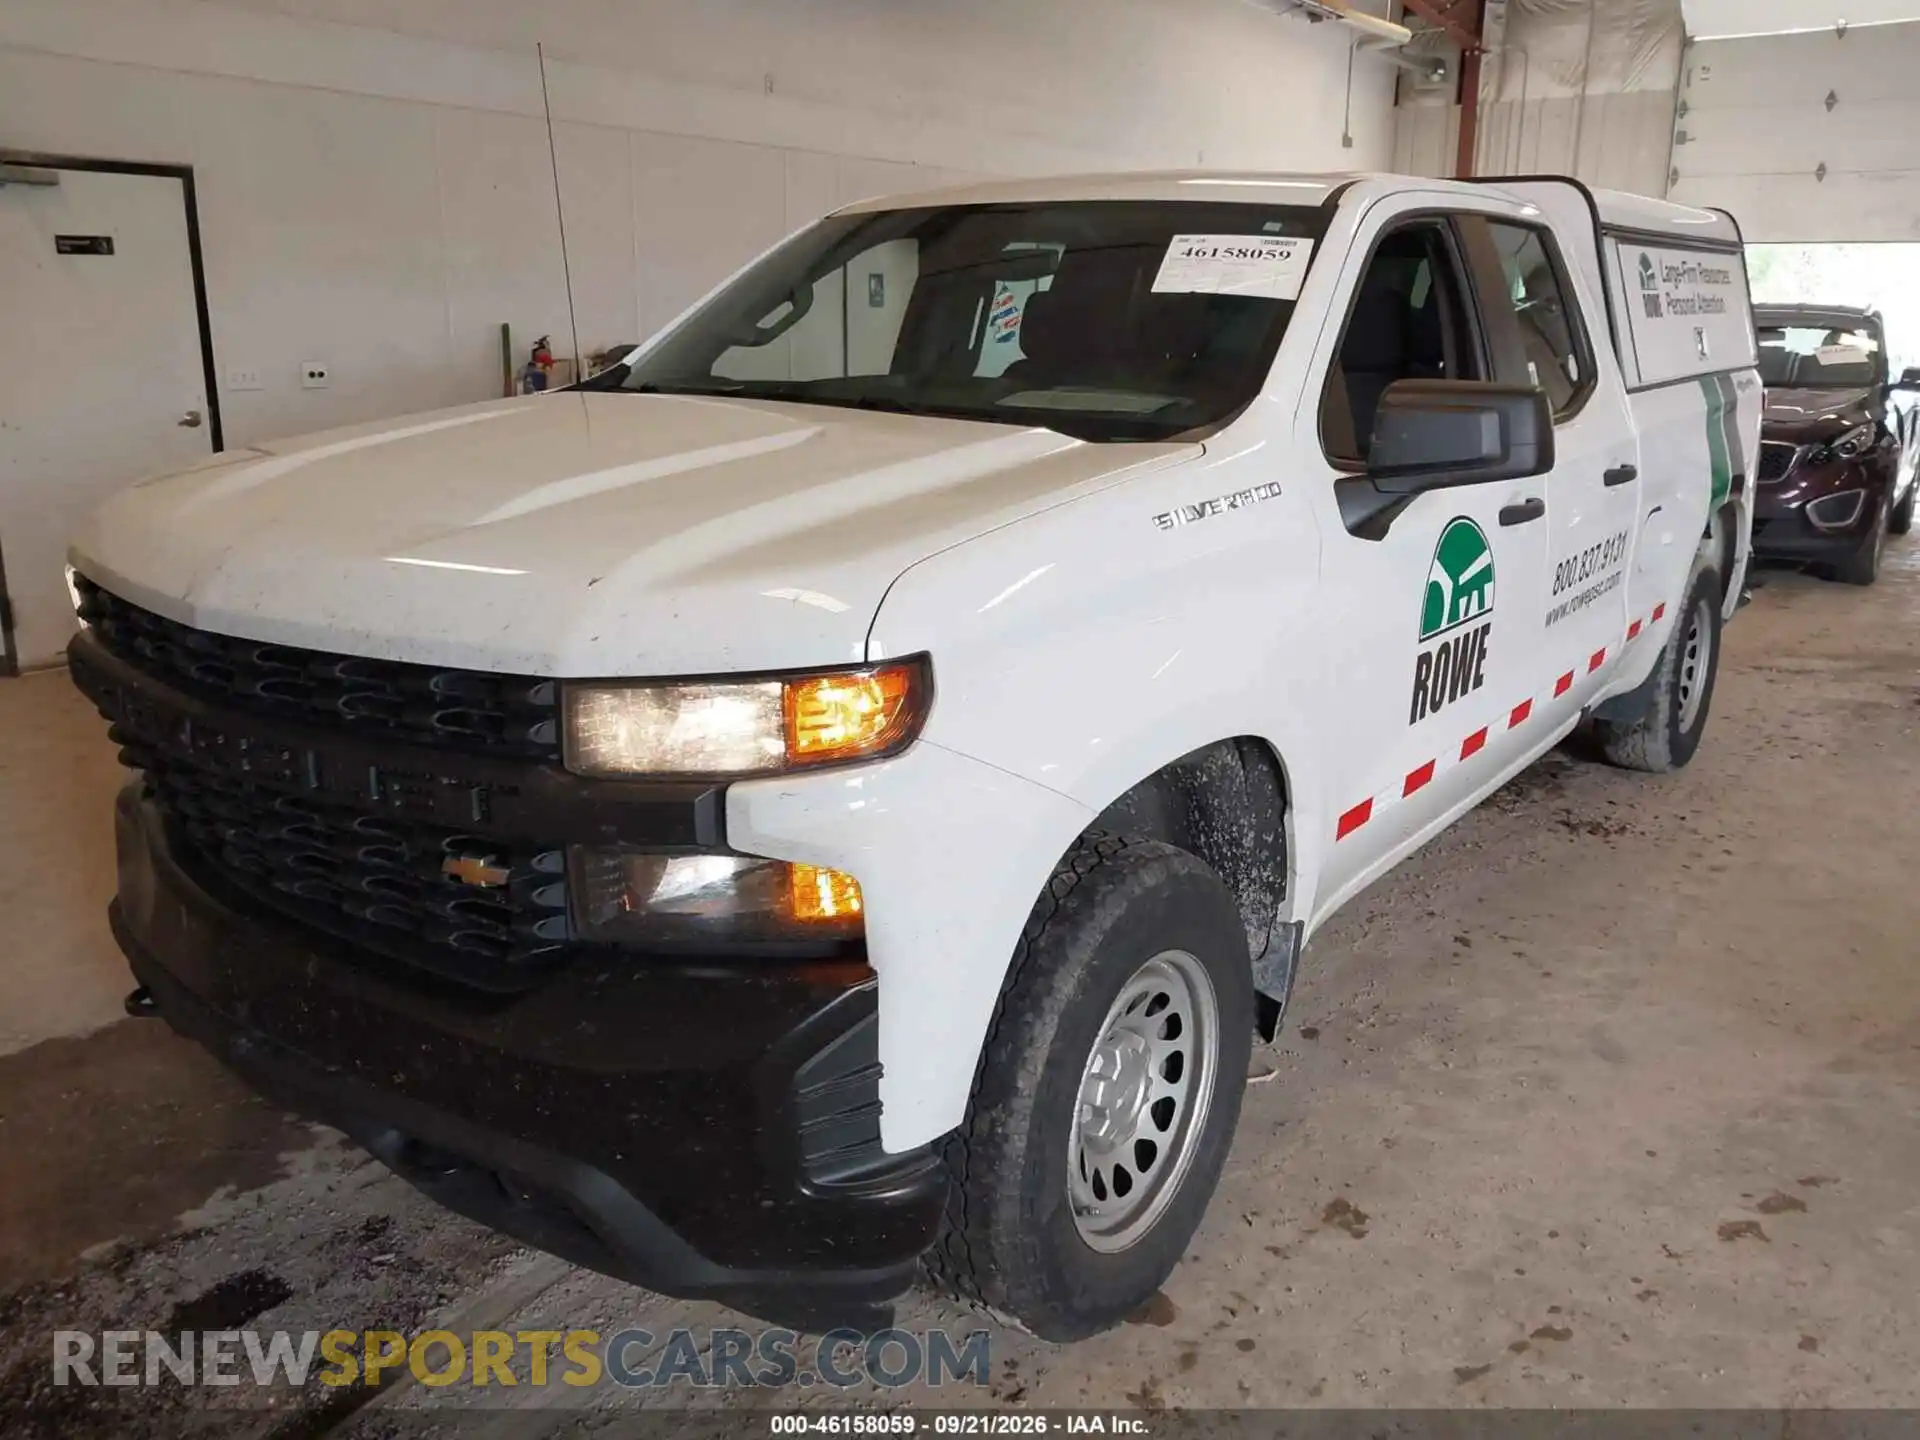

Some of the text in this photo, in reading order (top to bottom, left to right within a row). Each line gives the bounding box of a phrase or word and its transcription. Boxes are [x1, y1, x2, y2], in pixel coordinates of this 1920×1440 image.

[1180, 245, 1293, 261] 46158059
[1666, 291, 1697, 315] Personal
[1151, 481, 1282, 530] SILVERADO
[1553, 530, 1628, 596] 800.837.9131
[1409, 622, 1491, 726] ROWE
